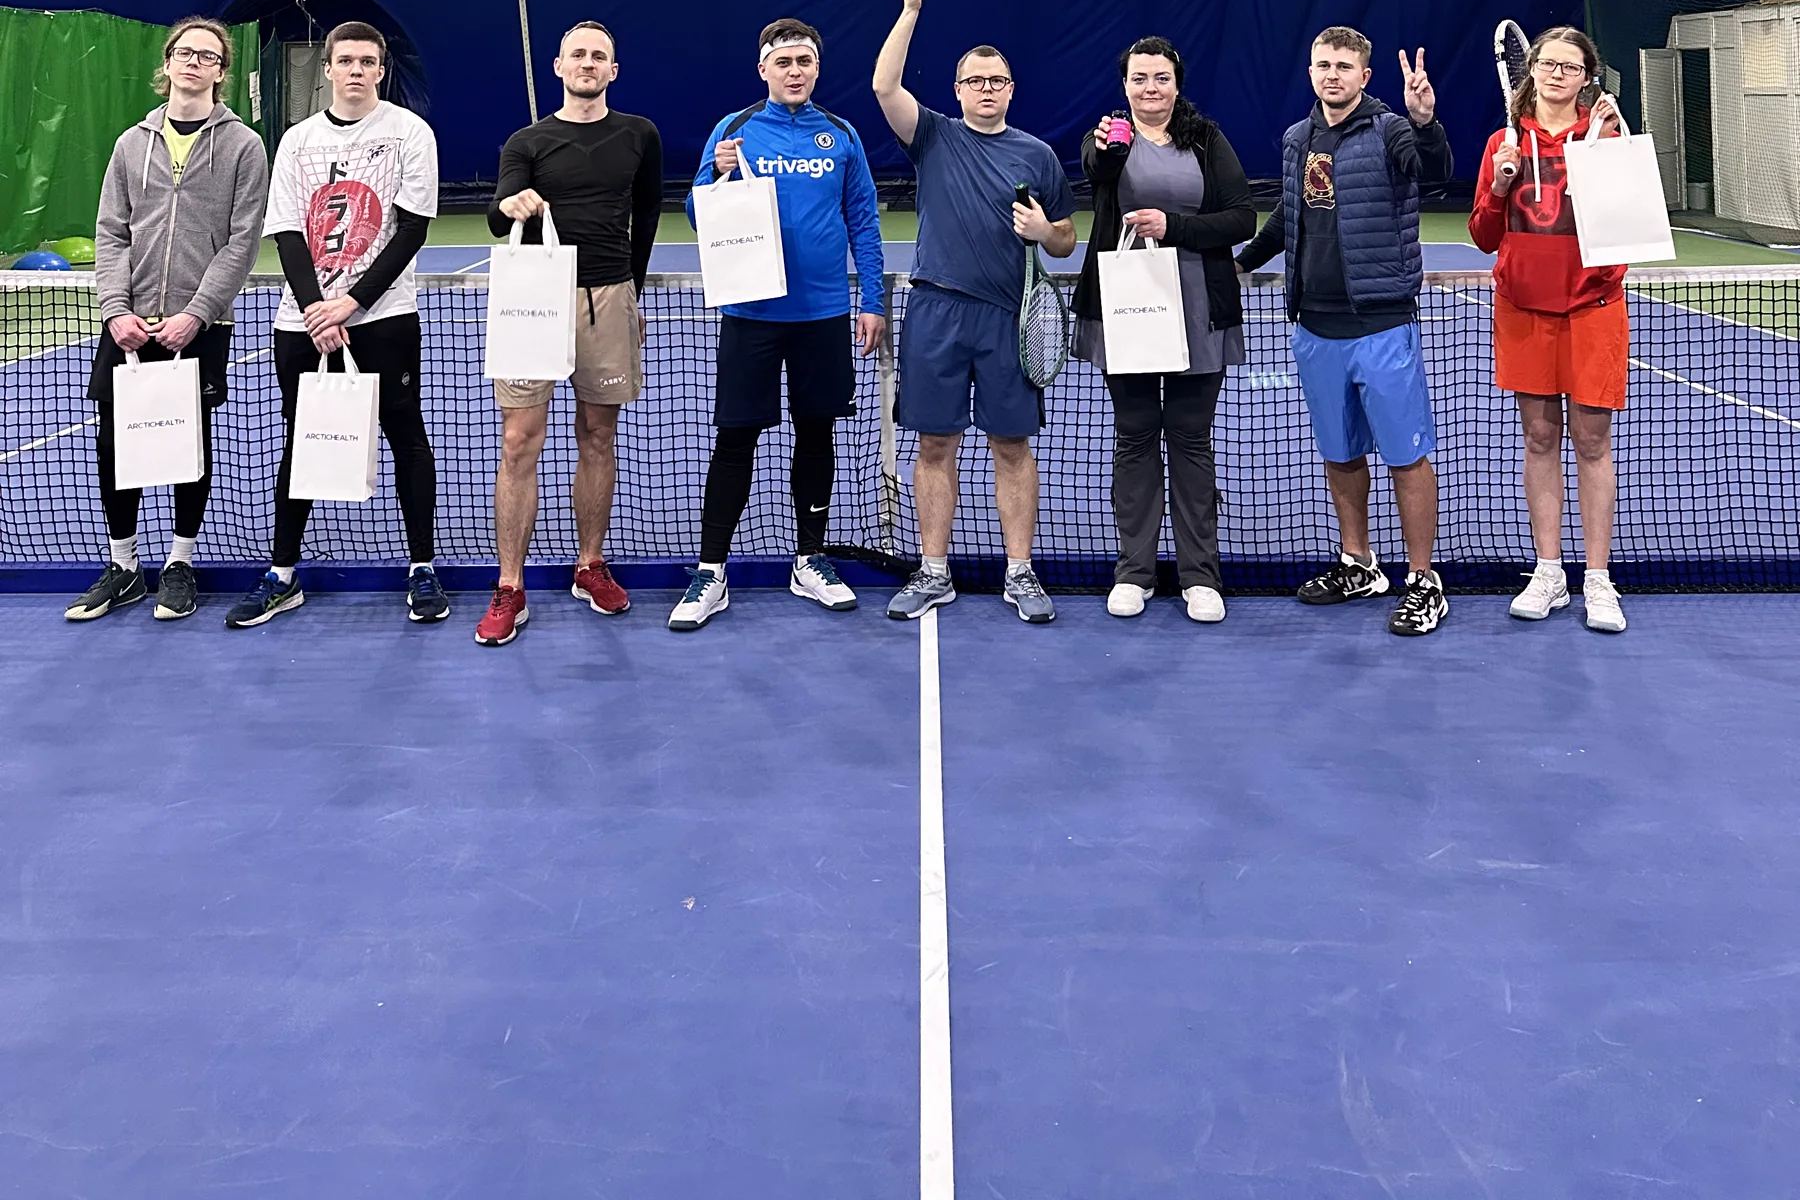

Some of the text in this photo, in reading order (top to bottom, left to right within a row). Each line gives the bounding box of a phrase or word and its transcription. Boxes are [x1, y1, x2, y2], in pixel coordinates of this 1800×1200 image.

[756, 155, 835, 179] trivago
[322, 160, 349, 290] ドラゴン
[710, 234, 764, 249] ARCTICHEALTH
[499, 308, 558, 318] ARCTICHEALTH
[1113, 306, 1167, 315] ARCTICHEALTH
[127, 418, 185, 431] ARCTICHEALTH
[305, 432, 359, 442] ARCTICHEALTH
